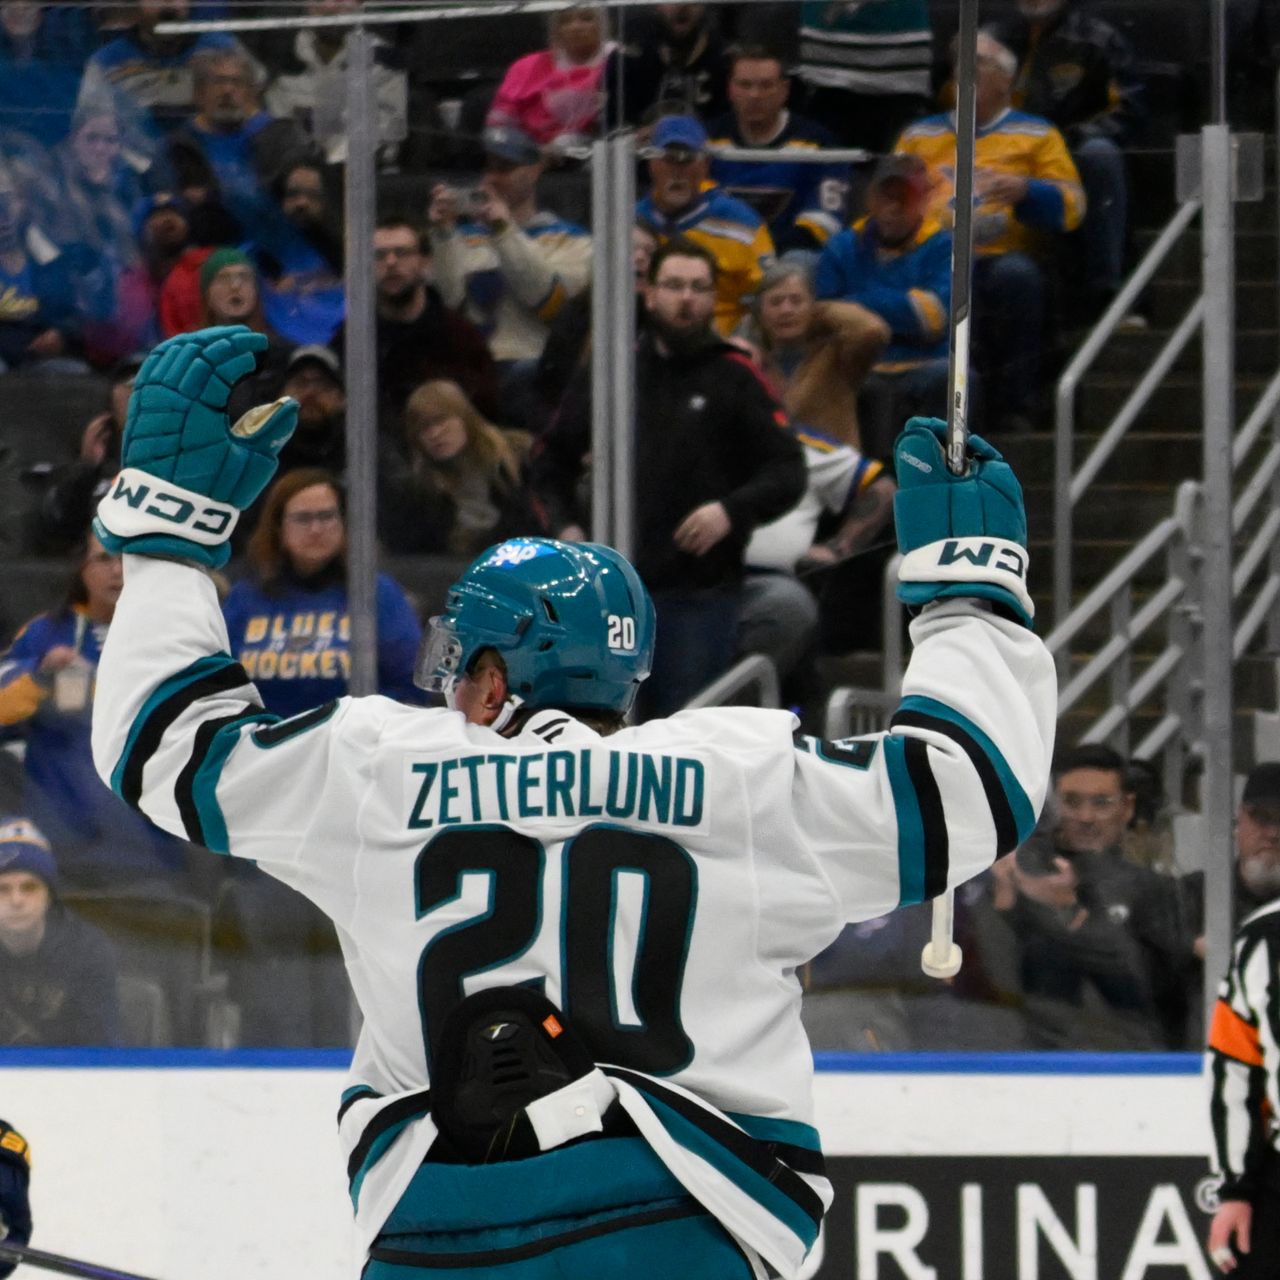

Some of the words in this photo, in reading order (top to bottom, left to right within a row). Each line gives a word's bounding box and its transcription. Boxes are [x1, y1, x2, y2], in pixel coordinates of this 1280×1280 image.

[112, 476, 232, 535] CCM
[937, 541, 1024, 580] CM
[607, 614, 635, 650] 20
[407, 748, 705, 831] ZETTERLUND
[414, 822, 699, 1086] 20
